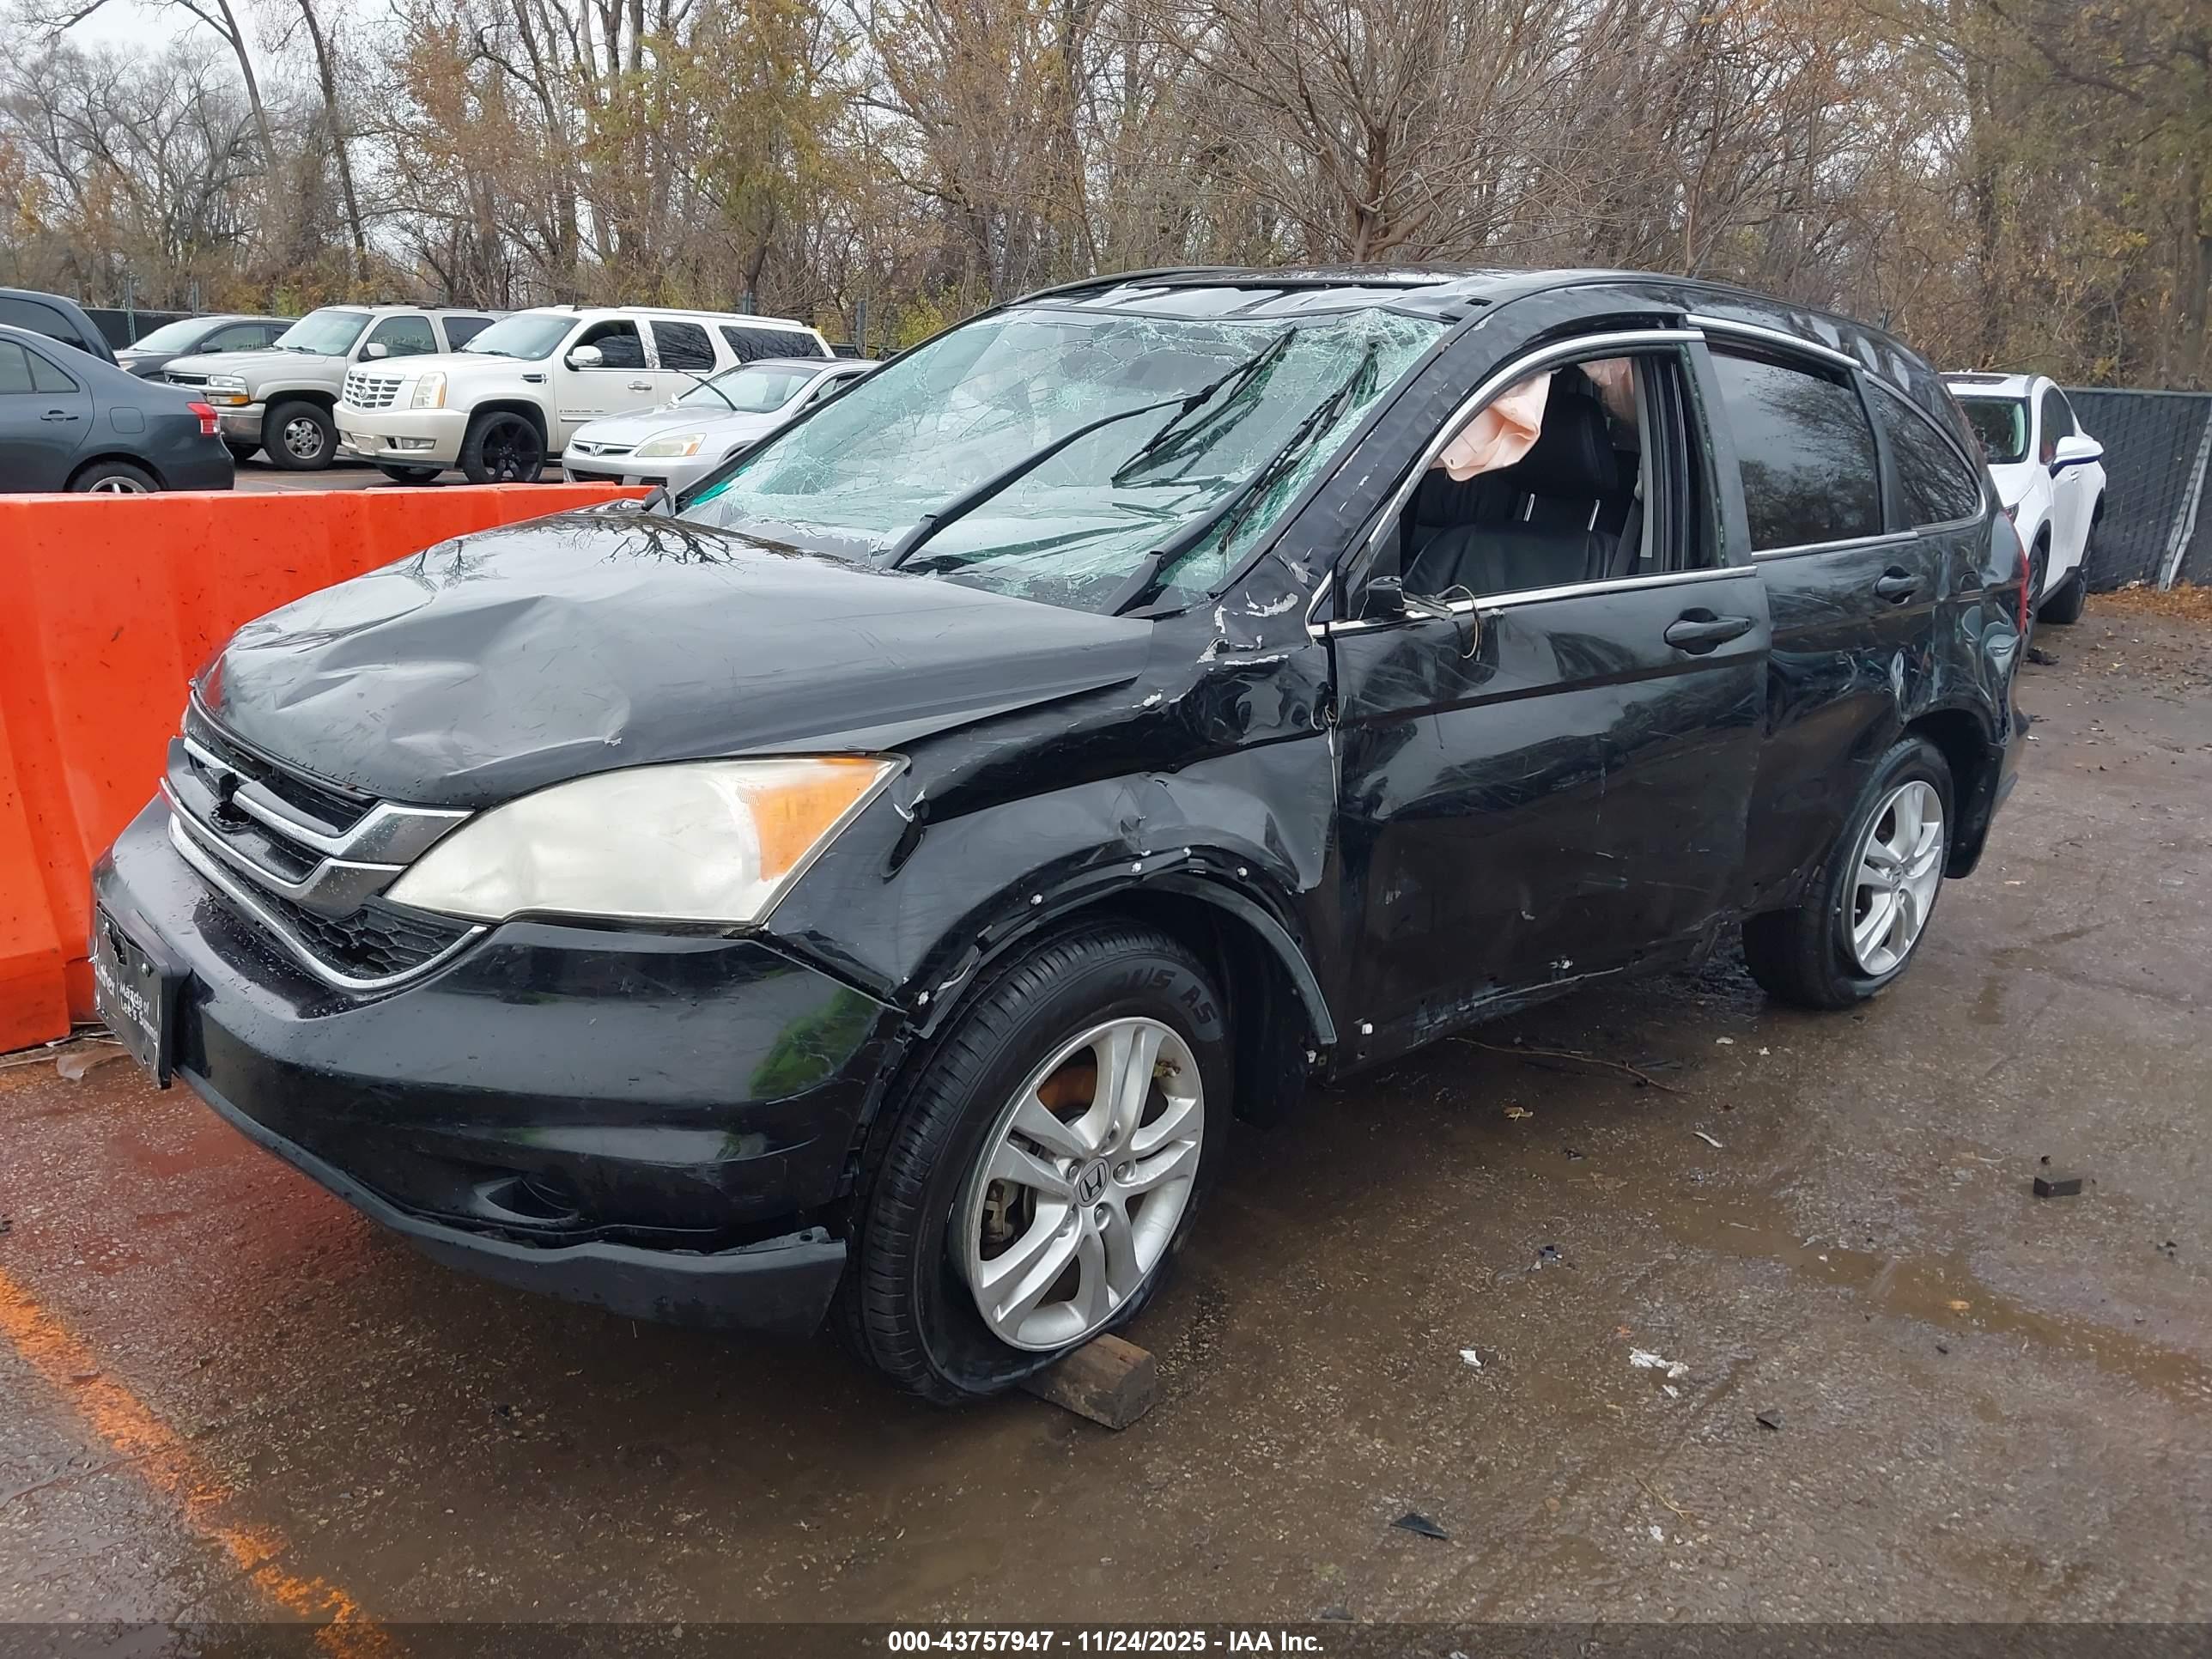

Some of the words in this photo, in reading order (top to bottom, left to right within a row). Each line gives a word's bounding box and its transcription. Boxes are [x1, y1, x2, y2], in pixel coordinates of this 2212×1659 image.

[119, 980, 143, 1009] Mazda
[143, 1000, 150, 1016] of
[120, 995, 137, 1021] Lee's
[138, 1009, 159, 1041] Summit
